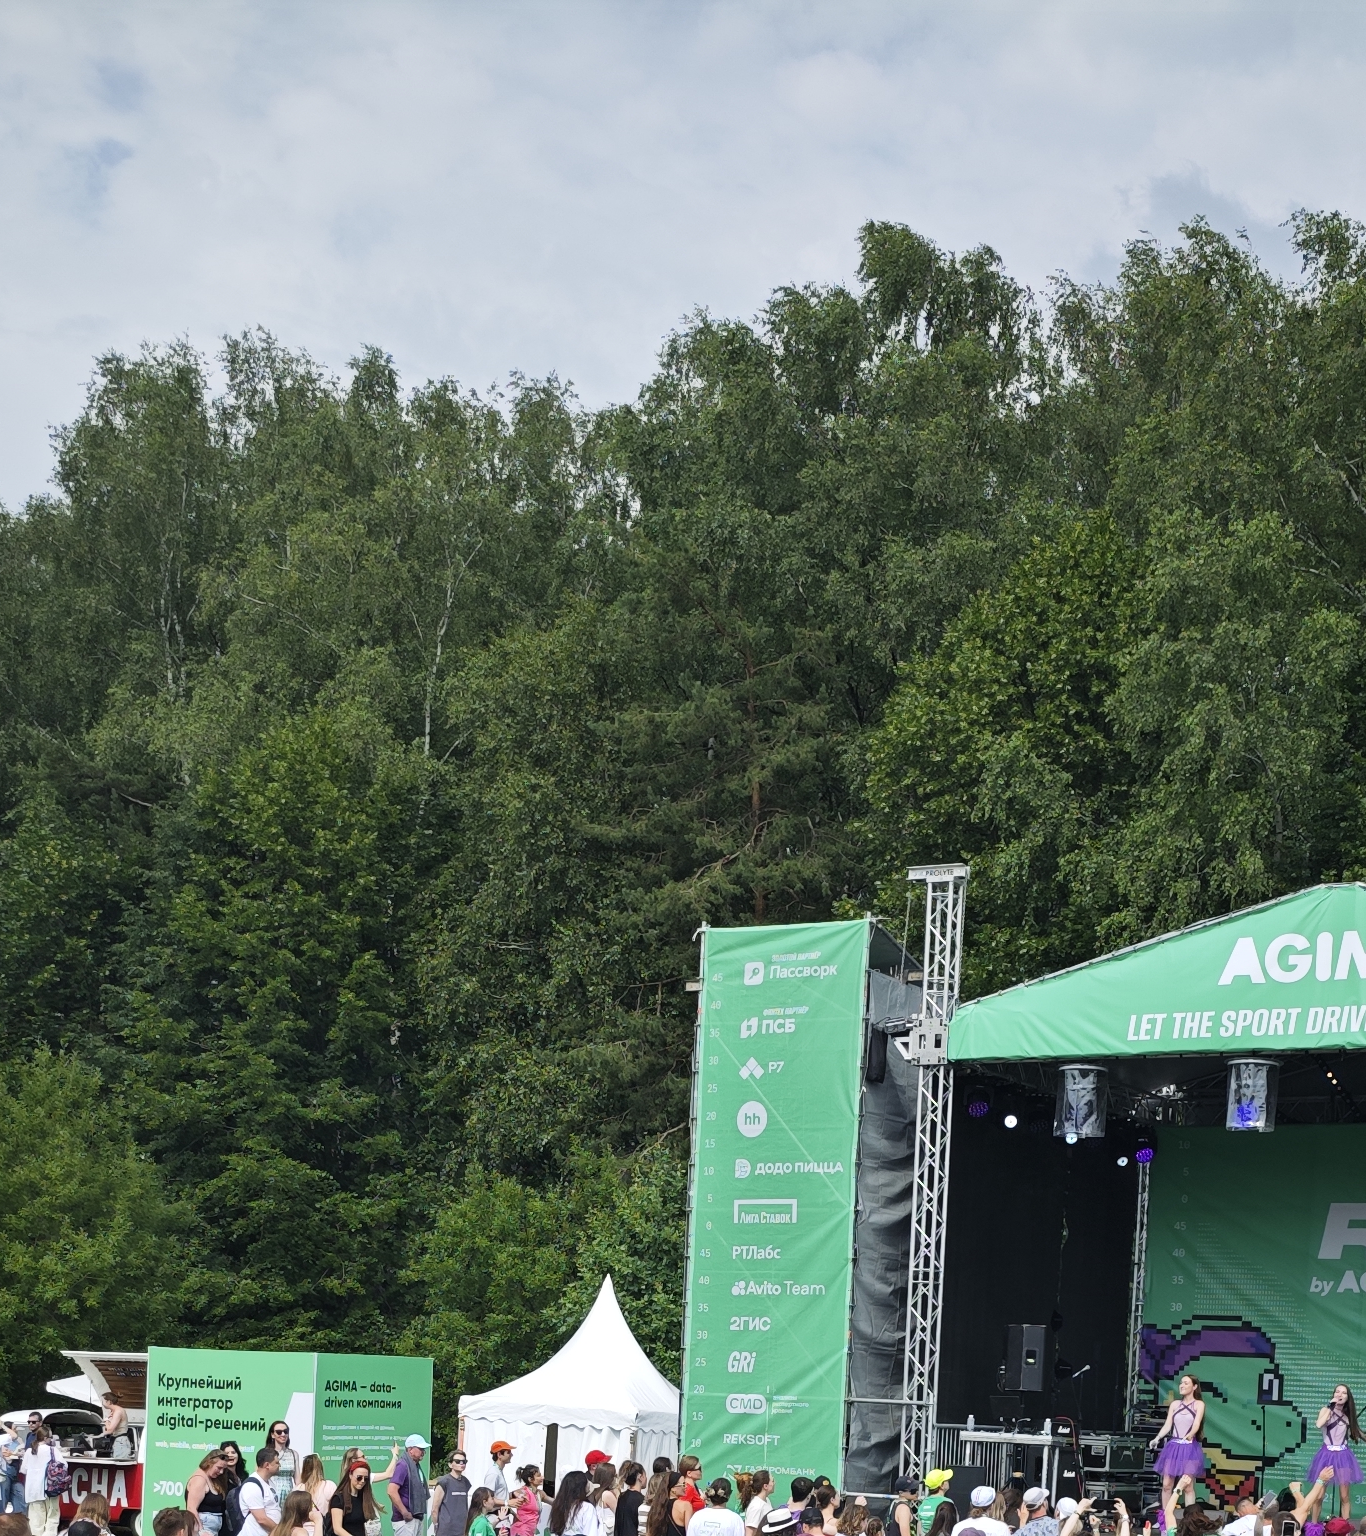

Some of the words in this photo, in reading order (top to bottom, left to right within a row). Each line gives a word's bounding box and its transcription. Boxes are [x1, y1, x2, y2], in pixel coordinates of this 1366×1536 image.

[769, 964, 838, 980] Пассворк
[712, 973, 723, 982] 45
[711, 1001, 722, 1010] 40
[761, 1018, 796, 1035] ПСБ
[1127, 1012, 1167, 1042] LET
[1171, 1009, 1213, 1039] THE
[1218, 1006, 1301, 1038] SPORT
[709, 1028, 720, 1038] 35
[708, 1056, 719, 1065] 30
[768, 1061, 785, 1074] Р7
[707, 1083, 718, 1094] 25
[706, 1111, 717, 1121] 20
[744, 1112, 761, 1126] hh
[704, 1139, 716, 1148] 15
[704, 1166, 715, 1176] 10
[794, 1161, 844, 1176] ПИЦЦА
[707, 1194, 713, 1203] 5
[706, 1221, 712, 1231] 0
[700, 1248, 711, 1258] 45
[732, 1245, 782, 1260] РТЛабс
[698, 1275, 710, 1285] 40
[1171, 1275, 1184, 1285] 35
[745, 1281, 782, 1296] Avito
[783, 1281, 826, 1296] Team
[1309, 1276, 1334, 1297] by
[697, 1303, 709, 1312] 35
[1170, 1302, 1183, 1312] 30
[729, 1316, 772, 1332] 2ГИС
[696, 1330, 708, 1340] 30
[695, 1358, 707, 1367] 25
[158, 1373, 242, 1391] Крупнейший
[324, 1380, 357, 1392] AGIMA
[369, 1381, 396, 1393] data-
[693, 1384, 705, 1394] 20
[157, 1395, 233, 1413] интегратор
[324, 1395, 354, 1408] driven
[356, 1399, 402, 1409] компания
[730, 1397, 763, 1410] CMD
[692, 1411, 704, 1421] 15
[156, 1413, 266, 1432] digital-решений
[690, 1438, 702, 1448] 10
[722, 1433, 781, 1446] REKSOFT
[153, 1480, 183, 1497] >700
